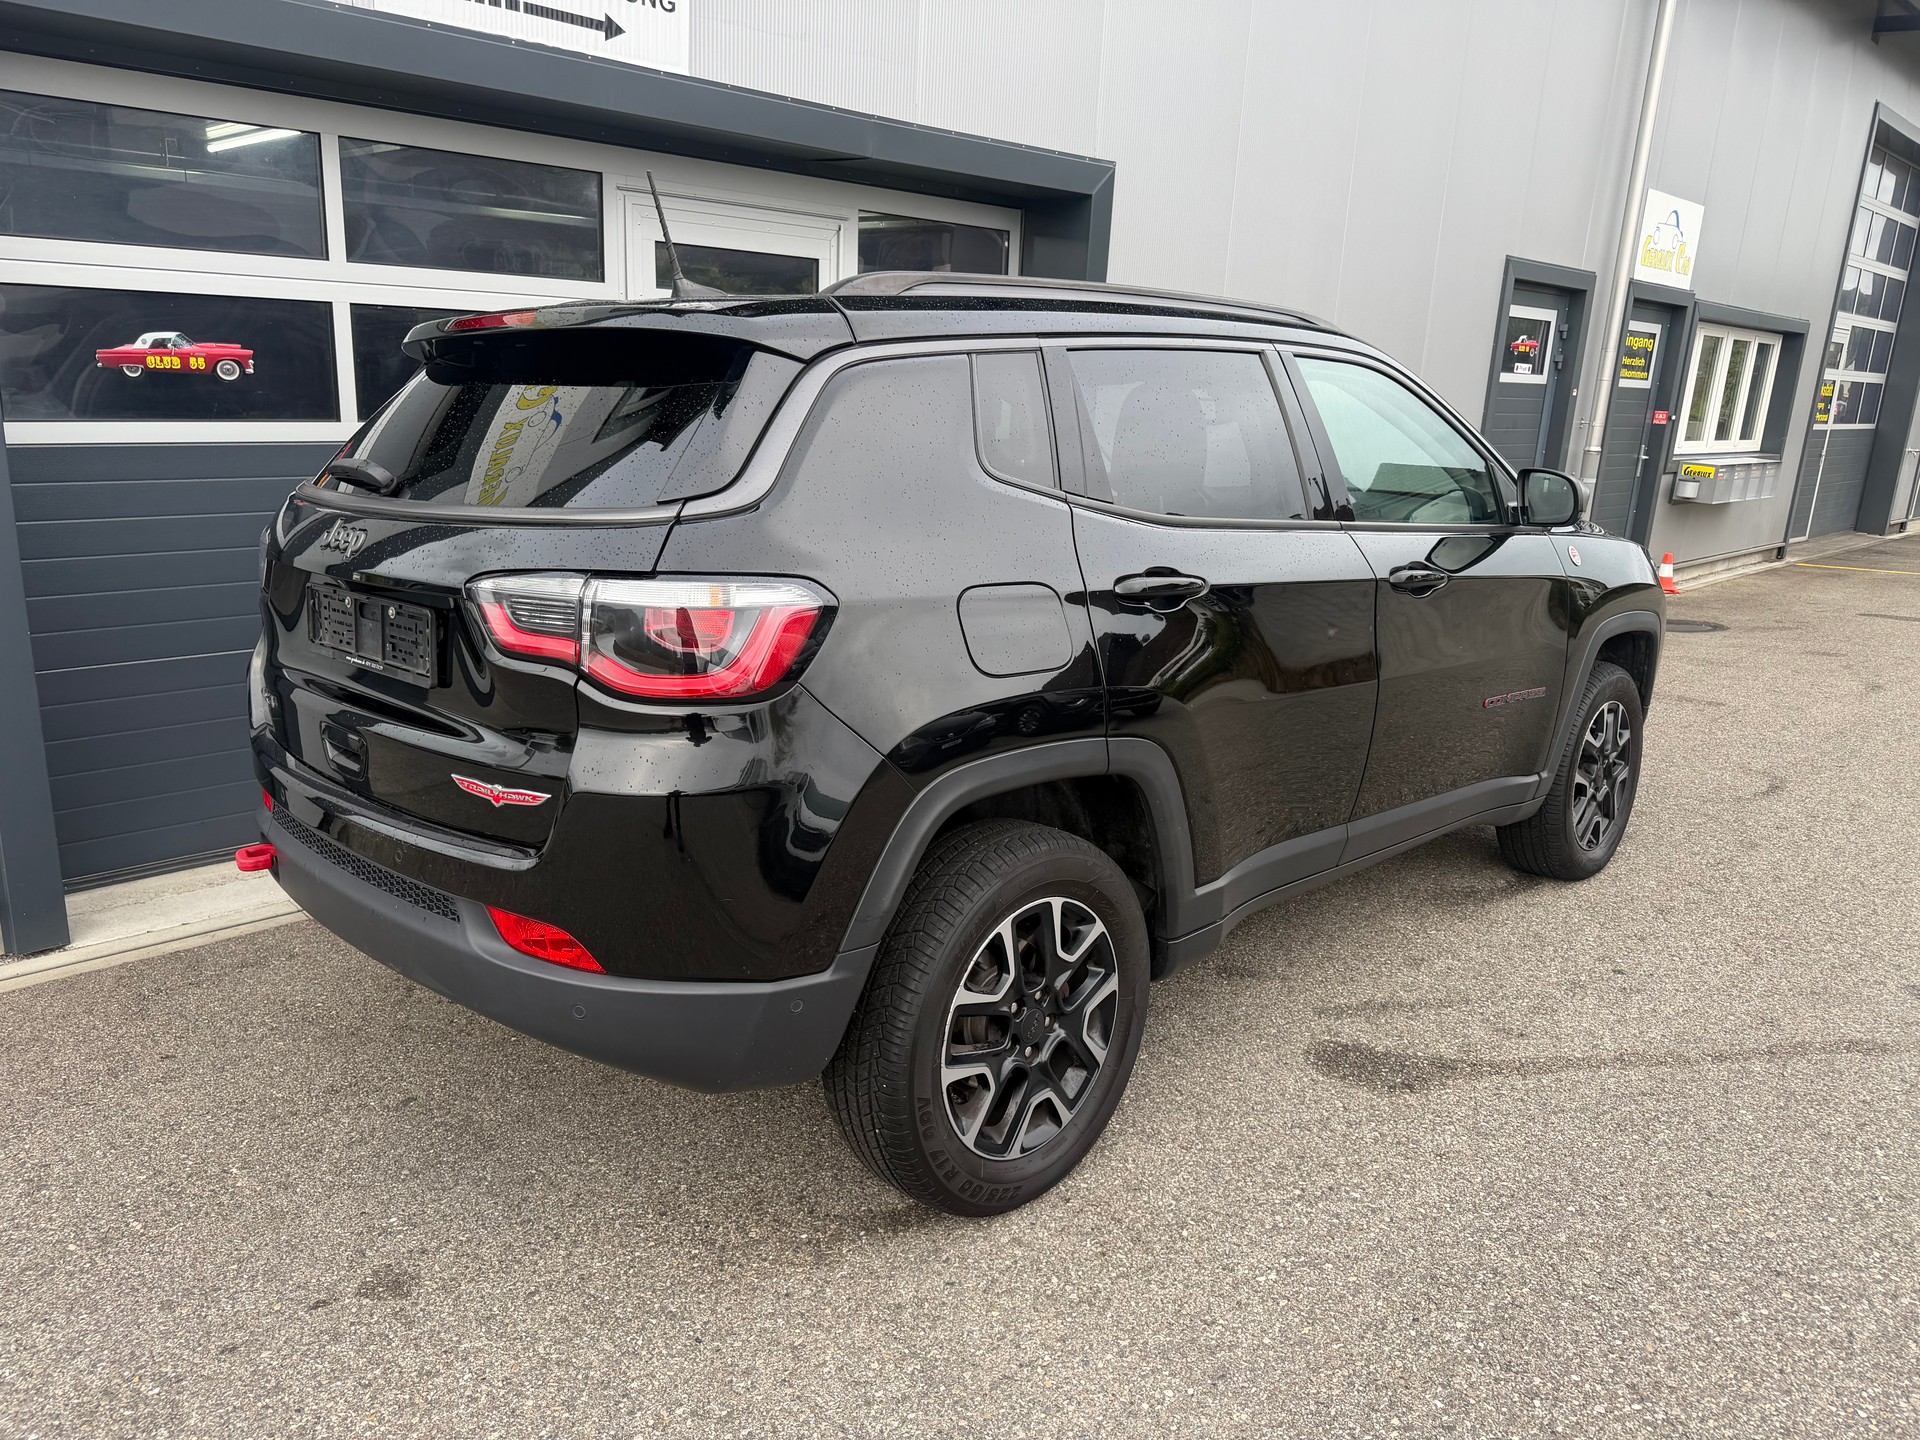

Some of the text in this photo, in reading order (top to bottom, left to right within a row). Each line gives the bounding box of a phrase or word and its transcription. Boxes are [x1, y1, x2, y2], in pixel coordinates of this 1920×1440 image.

[1625, 333, 1654, 352] ingang
[145, 356, 206, 370] CLUB 55
[1621, 356, 1646, 366] Herzlich
[1620, 368, 1648, 379] illkommen
[320, 516, 368, 562] Jeep
